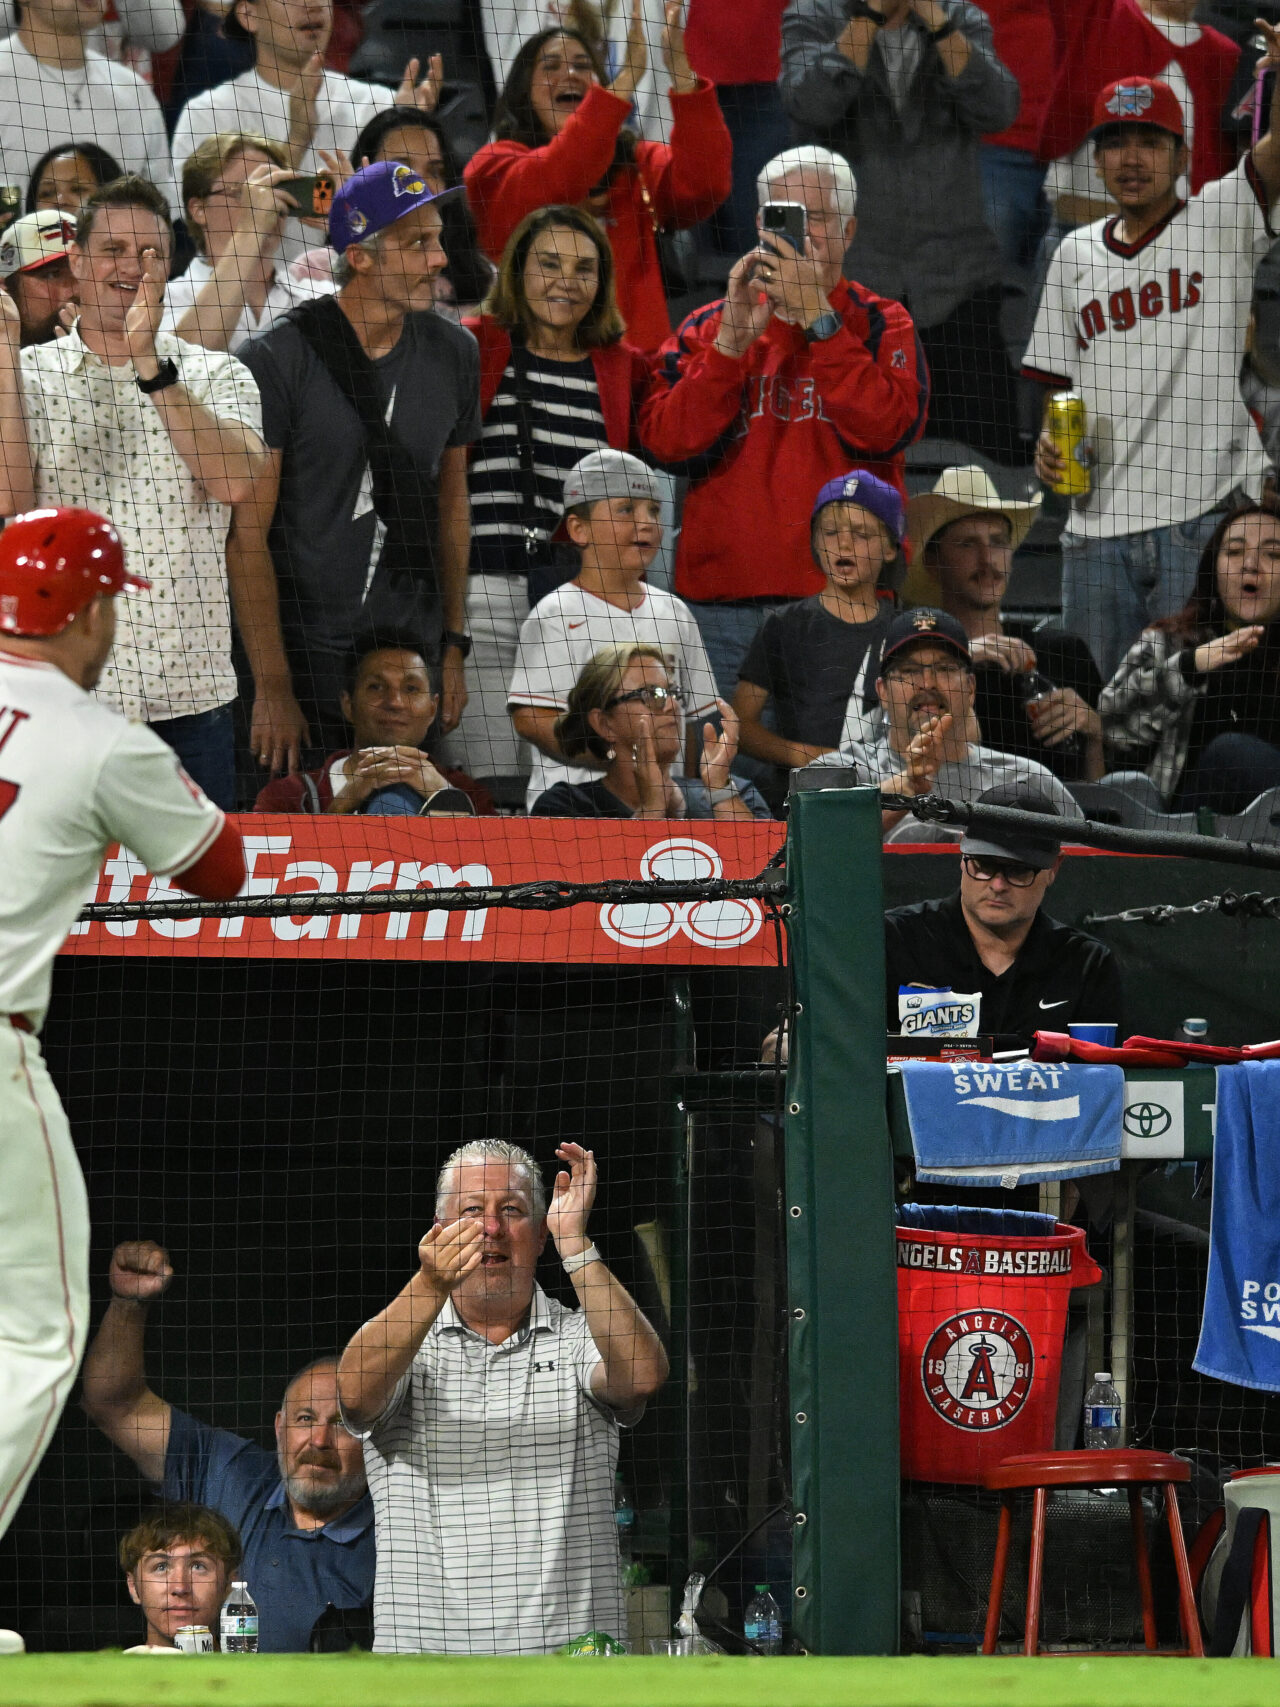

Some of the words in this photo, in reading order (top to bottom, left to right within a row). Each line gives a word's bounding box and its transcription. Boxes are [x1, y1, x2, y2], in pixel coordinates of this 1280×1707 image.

[1073, 268, 1203, 351] ngels
[903, 1003, 974, 1033] GIANTS
[954, 1071, 1063, 1094] SWEAT
[897, 1242, 963, 1270] NGELS
[984, 1249, 1072, 1274] BASEBALL
[945, 1316, 1020, 1342] ANGELS
[928, 1359, 946, 1375] 19
[1015, 1363, 1029, 1378] 61
[931, 1385, 1023, 1424] BASEBALL
